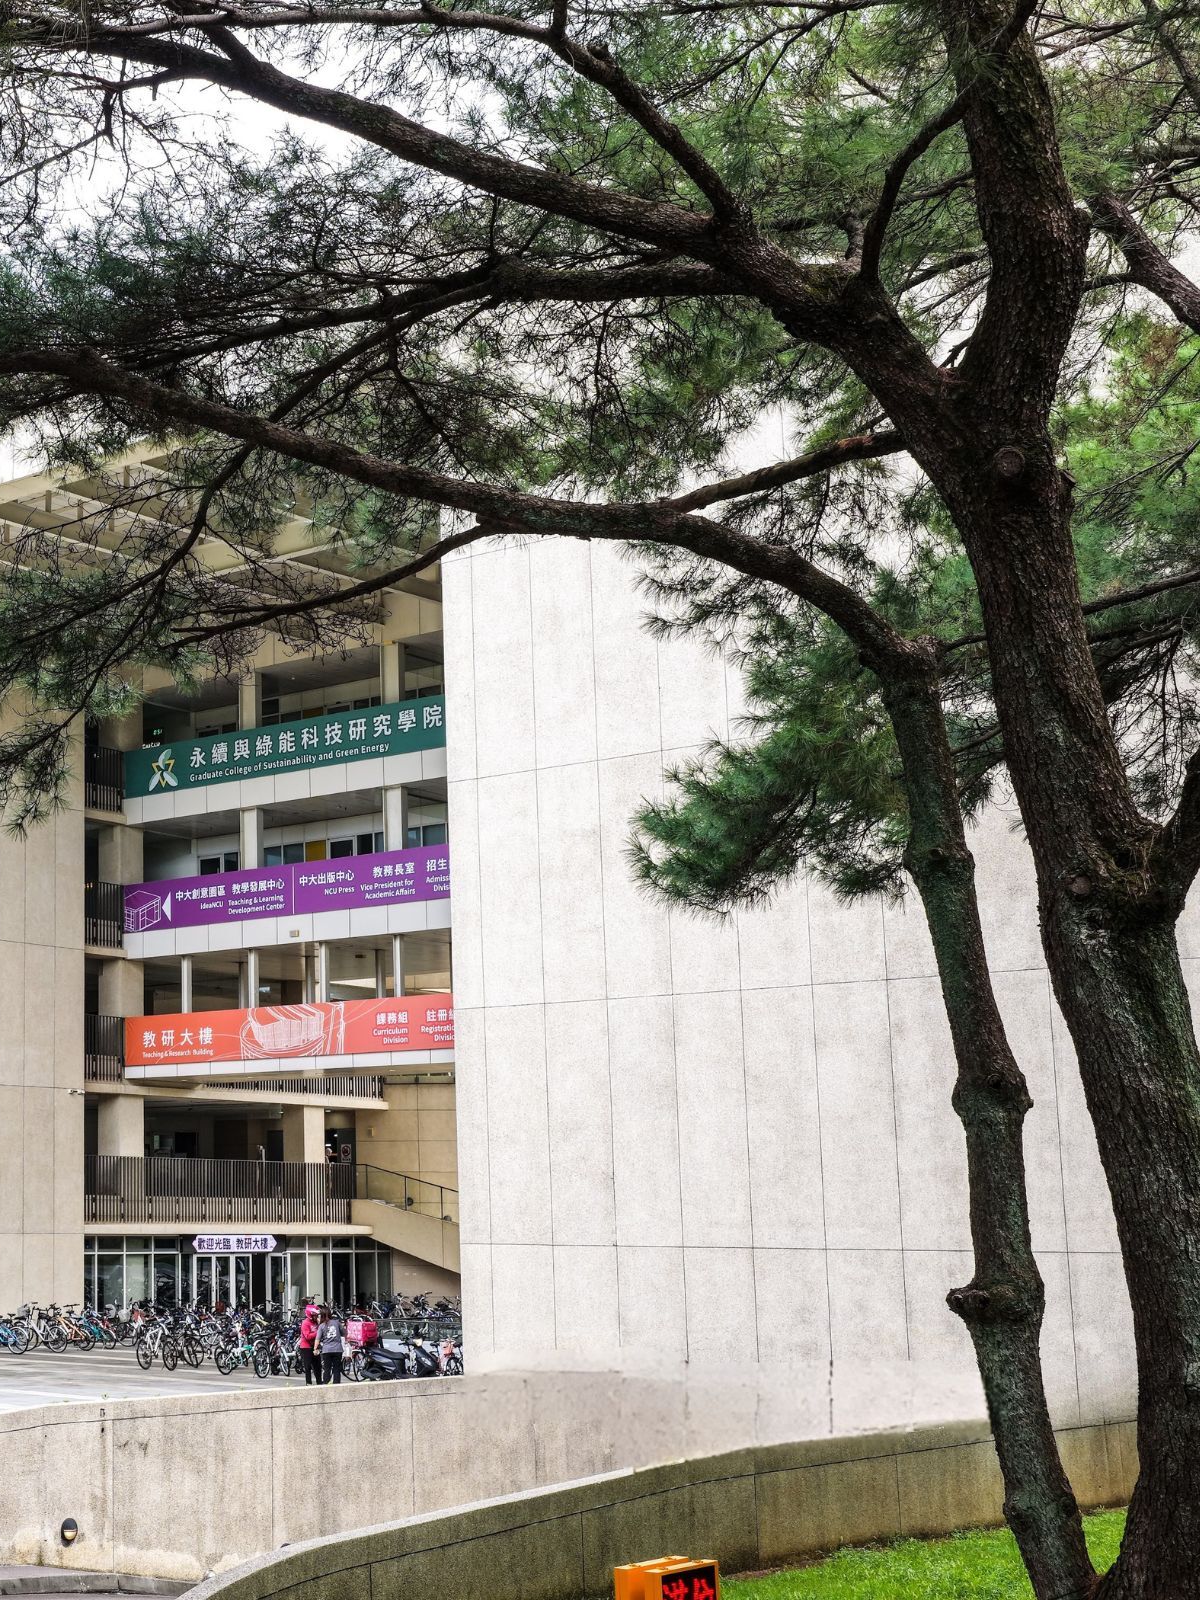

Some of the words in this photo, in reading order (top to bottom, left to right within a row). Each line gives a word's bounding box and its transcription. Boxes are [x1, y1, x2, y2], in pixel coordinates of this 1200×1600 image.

[190, 705, 442, 768] 永續與綠能科技研究學院
[190, 770, 223, 782] Graduate
[225, 766, 252, 775] College
[263, 754, 317, 770] Sustainability
[318, 750, 333, 760] and
[335, 748, 359, 758] Green
[361, 743, 390, 754] Energy
[372, 862, 415, 878] 教務長室
[426, 857, 450, 872] 招生
[299, 869, 355, 887] 中大出版中心
[374, 879, 404, 889] President
[232, 878, 285, 895] 教學發展中心
[324, 887, 338, 895] NCU
[338, 886, 355, 894] Press
[228, 897, 253, 906] Teaching
[258, 894, 284, 903] Learning
[364, 890, 395, 900] Academic
[395, 887, 416, 897] Affairs
[228, 904, 265, 915] Development
[266, 903, 285, 911] Center
[376, 1011, 408, 1025] 課務組
[143, 1026, 213, 1048] 教研大樓
[373, 1027, 408, 1036] Curriculum
[383, 1036, 409, 1044] Division
[197, 1237, 231, 1250] 歡迎光臨
[235, 1237, 269, 1250] 教研大樓
